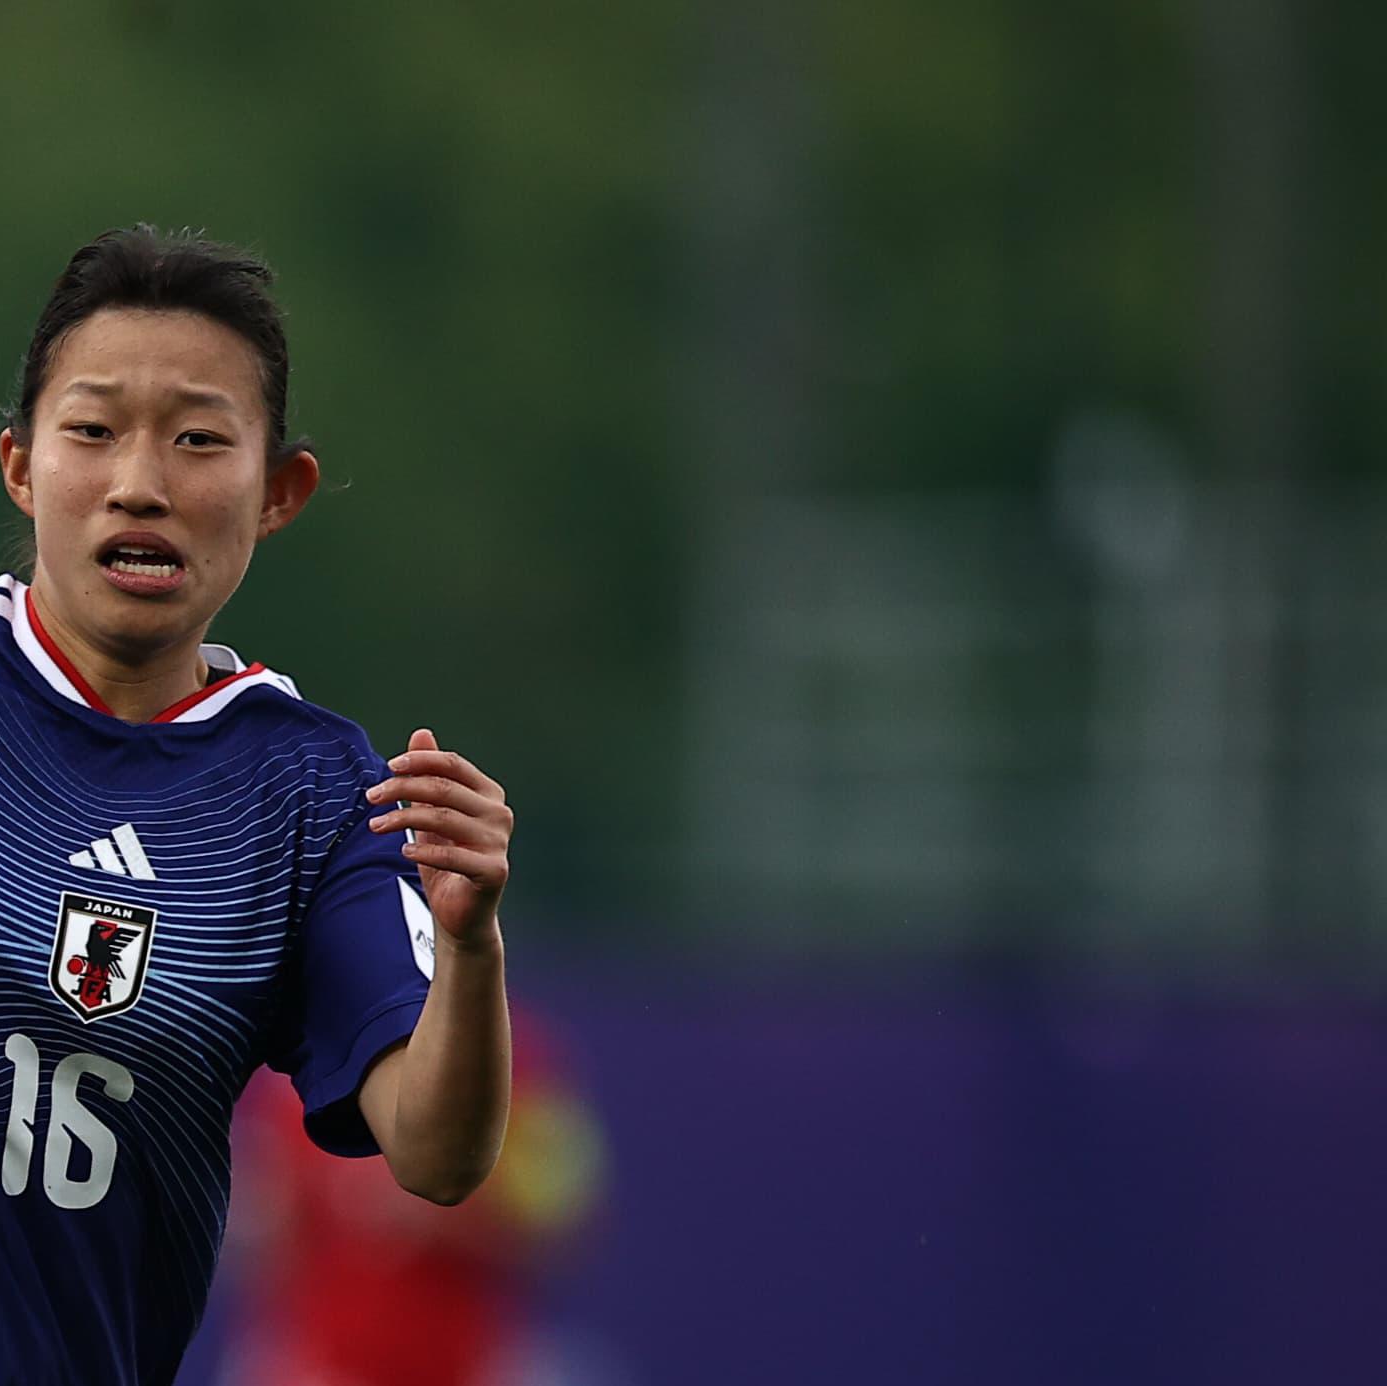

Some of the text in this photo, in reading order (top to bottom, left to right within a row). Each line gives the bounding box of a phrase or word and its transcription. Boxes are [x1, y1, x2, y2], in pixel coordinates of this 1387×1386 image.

[84, 901, 133, 919] JAPAN
[70, 977, 112, 1003] JFA
[1, 1033, 134, 1210] 16
